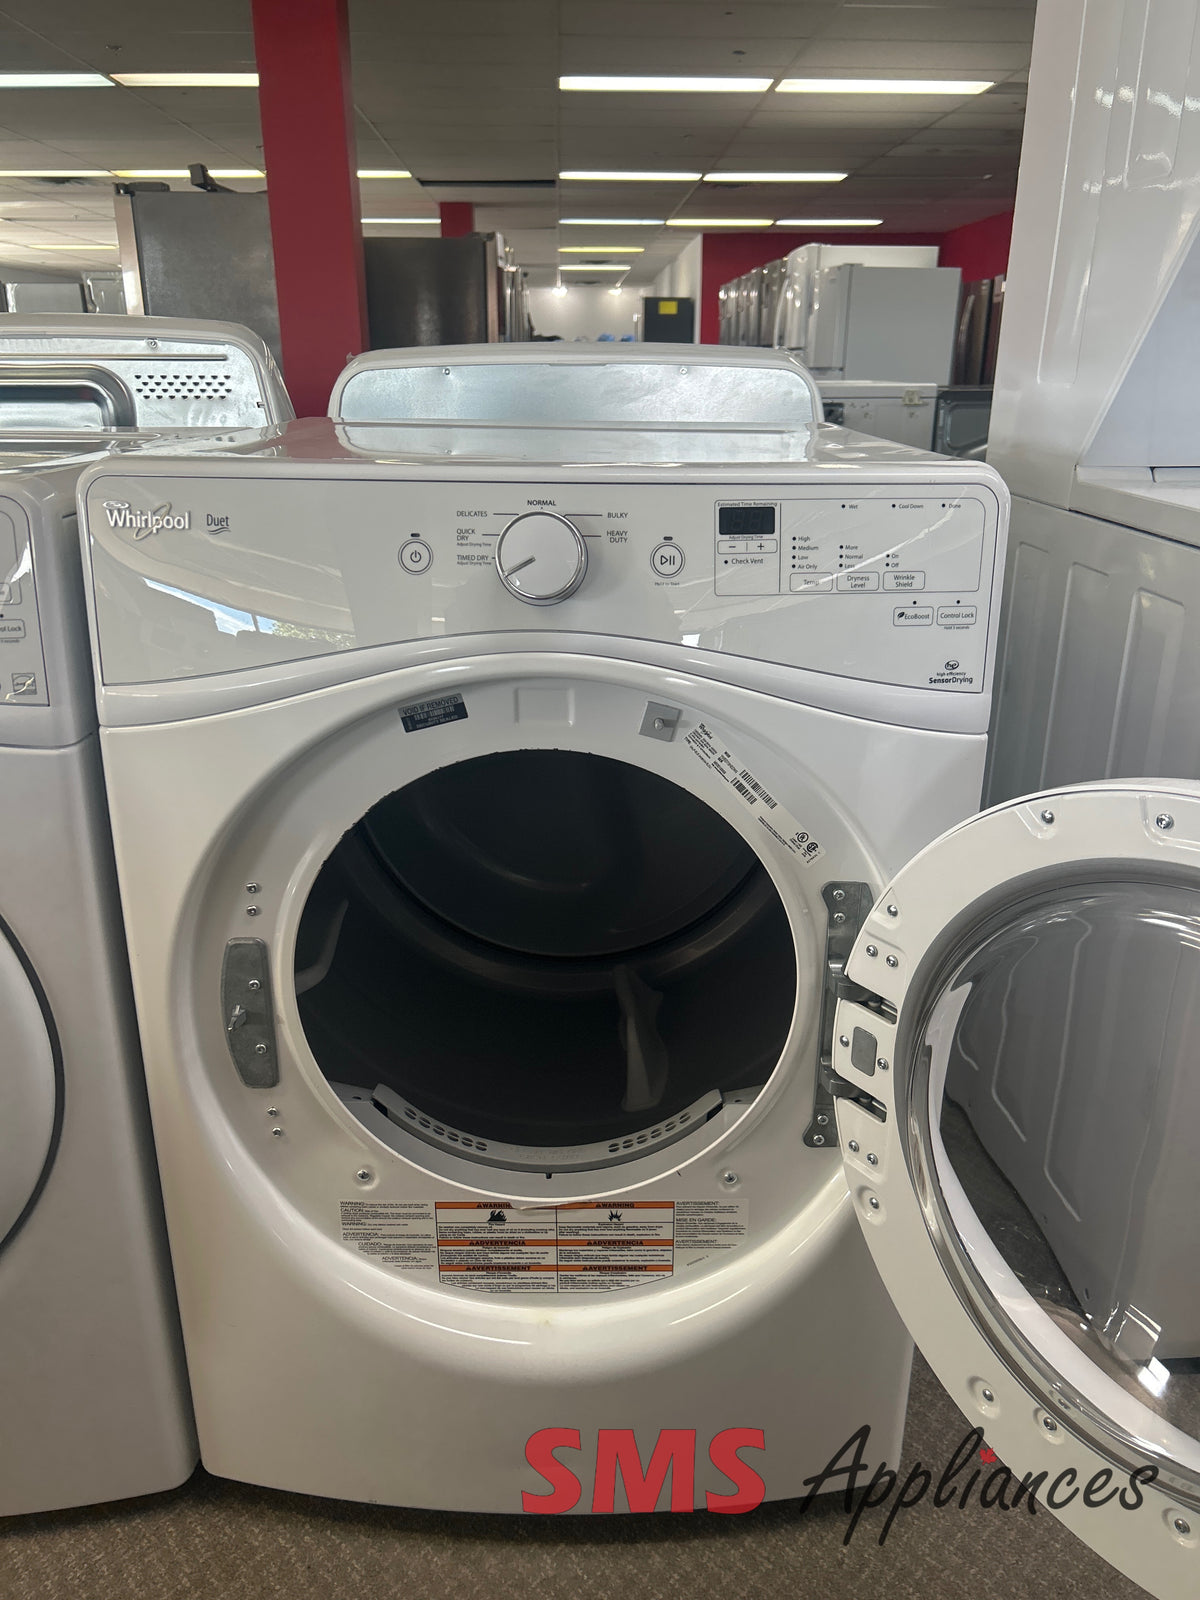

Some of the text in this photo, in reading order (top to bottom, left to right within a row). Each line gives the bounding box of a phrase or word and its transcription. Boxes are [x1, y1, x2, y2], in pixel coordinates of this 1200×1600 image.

[105, 507, 191, 534] Whirlpool
[206, 513, 230, 527] Duet
[609, 536, 628, 544] DUTY
[806, 563, 818, 571] Only
[846, 574, 871, 582] Dryness
[928, 676, 974, 684] SensorDrying
[427, 697, 458, 709] REMOVED
